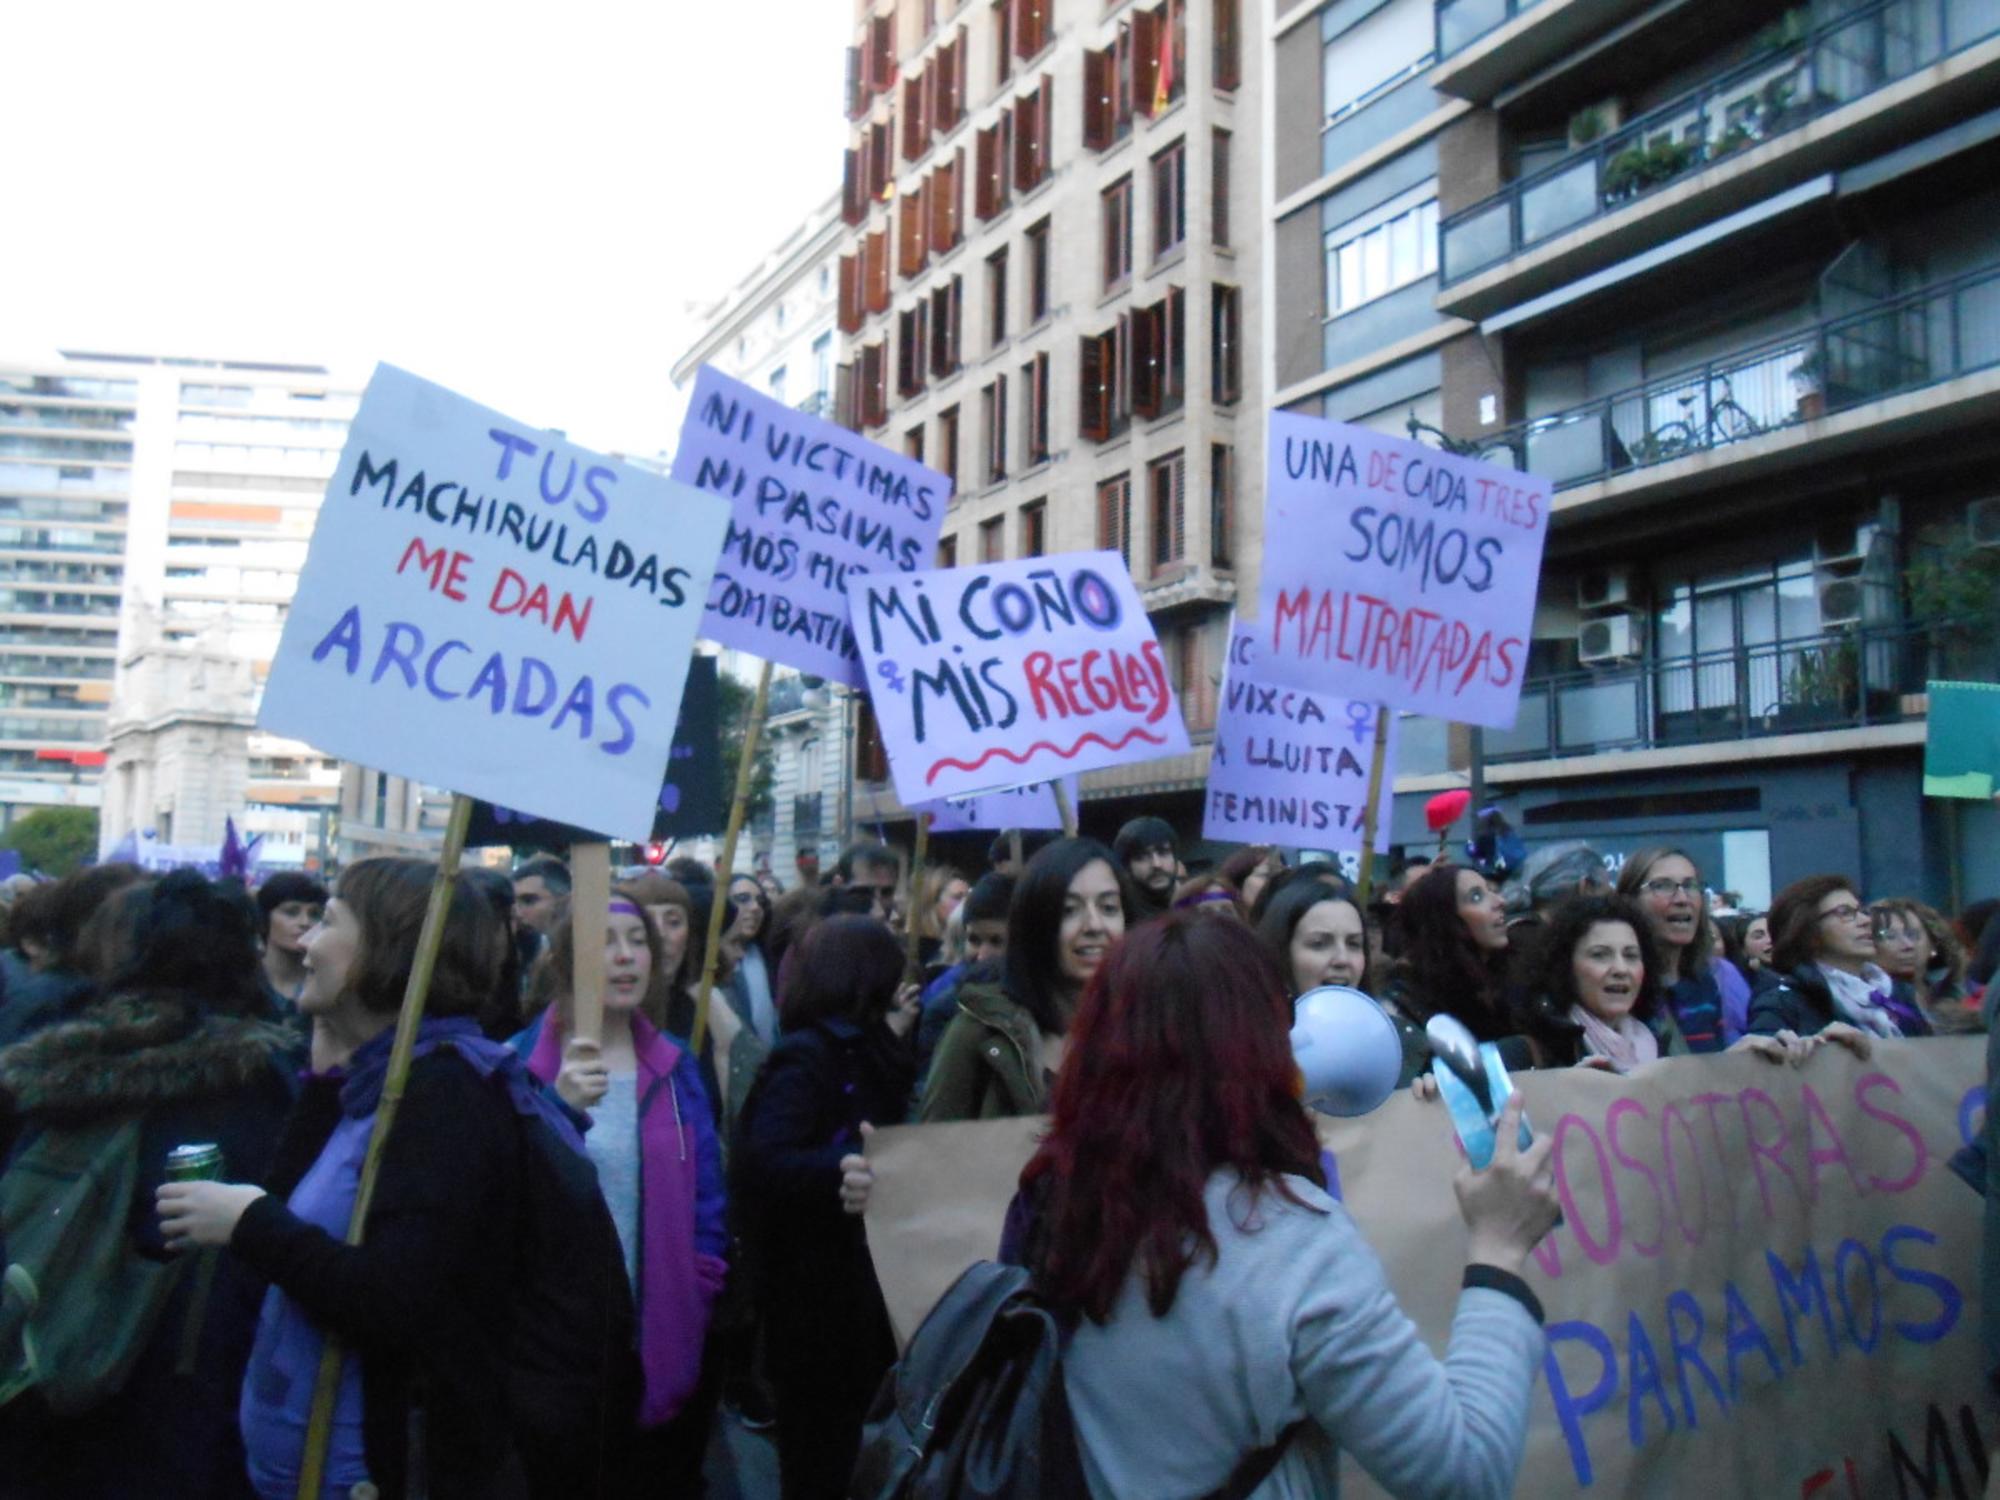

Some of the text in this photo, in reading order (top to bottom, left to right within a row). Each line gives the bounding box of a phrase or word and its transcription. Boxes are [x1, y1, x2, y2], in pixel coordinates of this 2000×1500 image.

[488, 427, 619, 523] TUS
[702, 391, 935, 522] NI VICTIMAS
[1285, 436, 1542, 529] UNA DE CADA TRES
[349, 450, 692, 608] MACHIRULADAS
[696, 456, 922, 572] NI PASIVAS
[1344, 506, 1503, 593] SOMOS
[397, 537, 594, 642] ME DAN
[959, 568, 1122, 640] COÑO
[1273, 586, 1524, 696] MALTRATADAS
[311, 605, 651, 756] ARCADAS
[1022, 640, 1170, 724] REGLAS
[1245, 737, 1364, 777] LLUITA
[1544, 1223, 1964, 1488] PARAMOS
